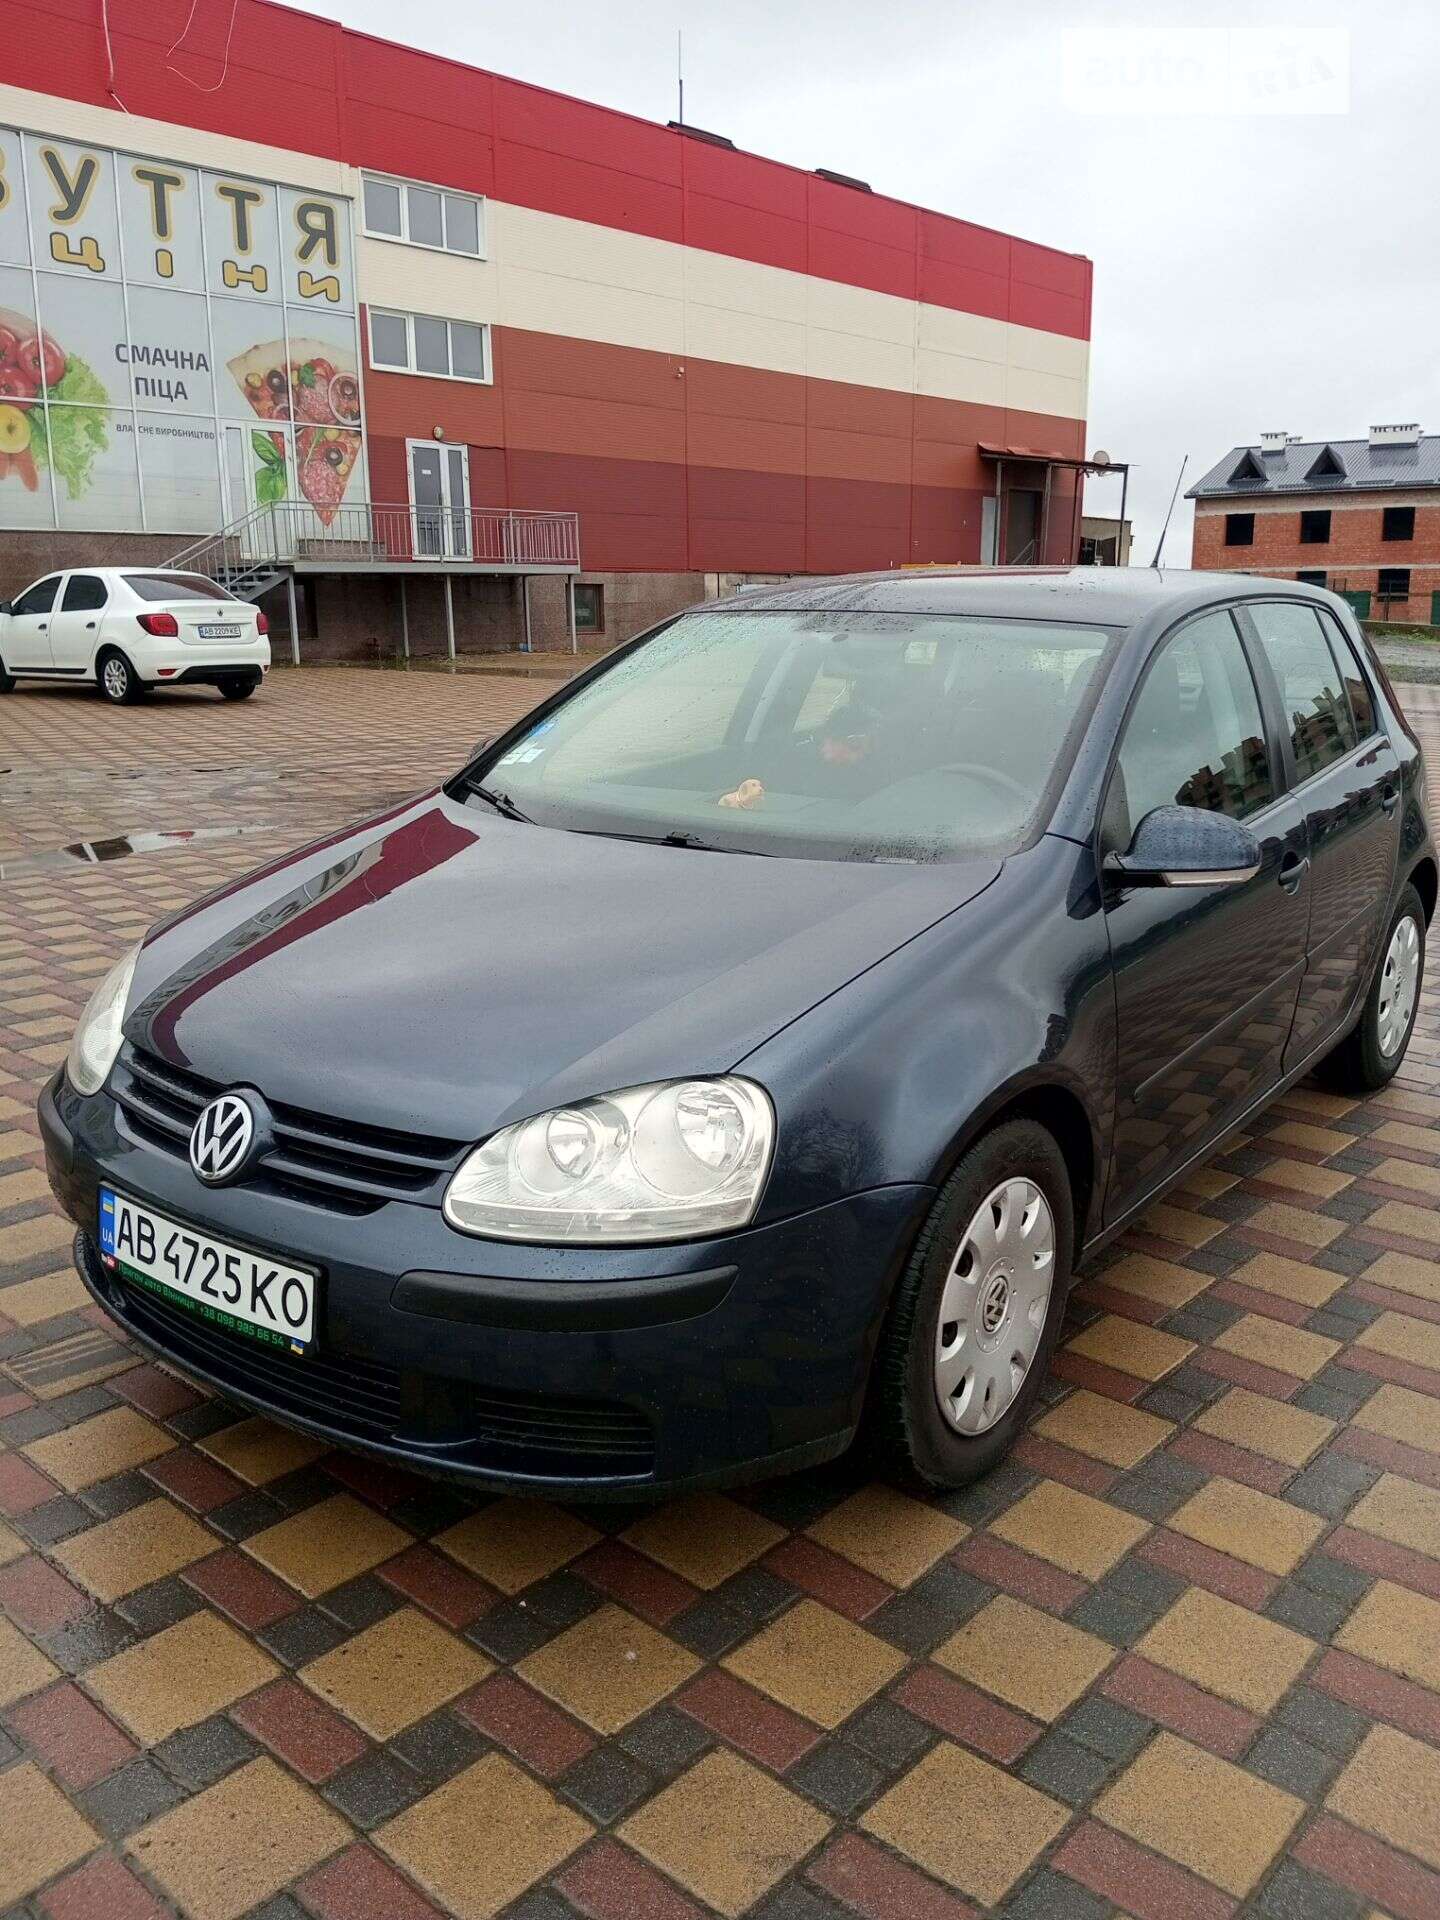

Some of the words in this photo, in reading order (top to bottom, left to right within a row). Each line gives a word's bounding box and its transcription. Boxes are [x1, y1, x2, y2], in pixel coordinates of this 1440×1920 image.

[0, 144, 341, 268] УТТЯ
[115, 343, 210, 372] СМАЧНА
[135, 376, 189, 403] ПІЦА
[155, 427, 216, 440] ВИРОБНИЦТВО
[102, 1227, 114, 1246] UA
